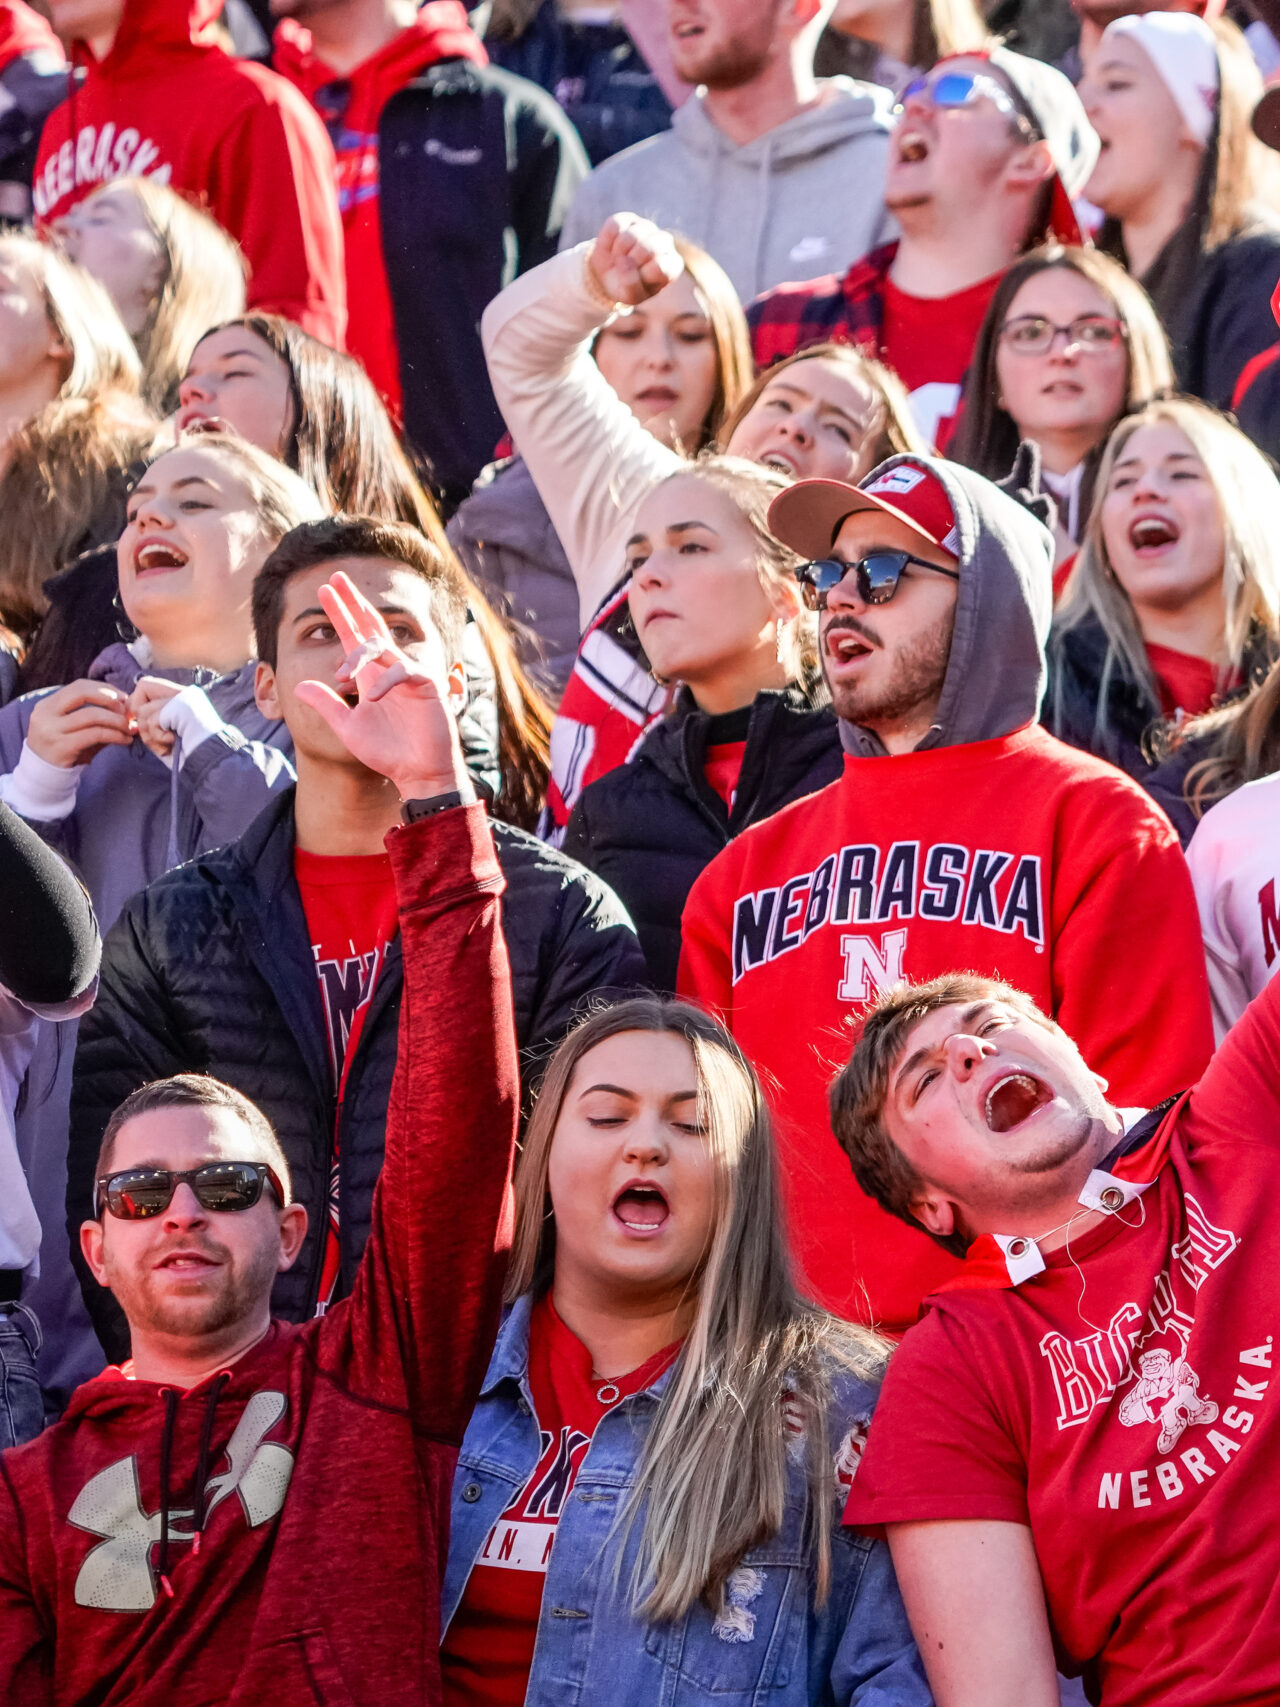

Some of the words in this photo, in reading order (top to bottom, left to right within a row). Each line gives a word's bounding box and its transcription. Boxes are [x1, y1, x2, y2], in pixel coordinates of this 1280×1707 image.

[732, 840, 1045, 987] NEBRASKA
[837, 927, 908, 1002] N
[1039, 1302, 1142, 1431] BIG
[1097, 1343, 1273, 1510] NEBRASKA
